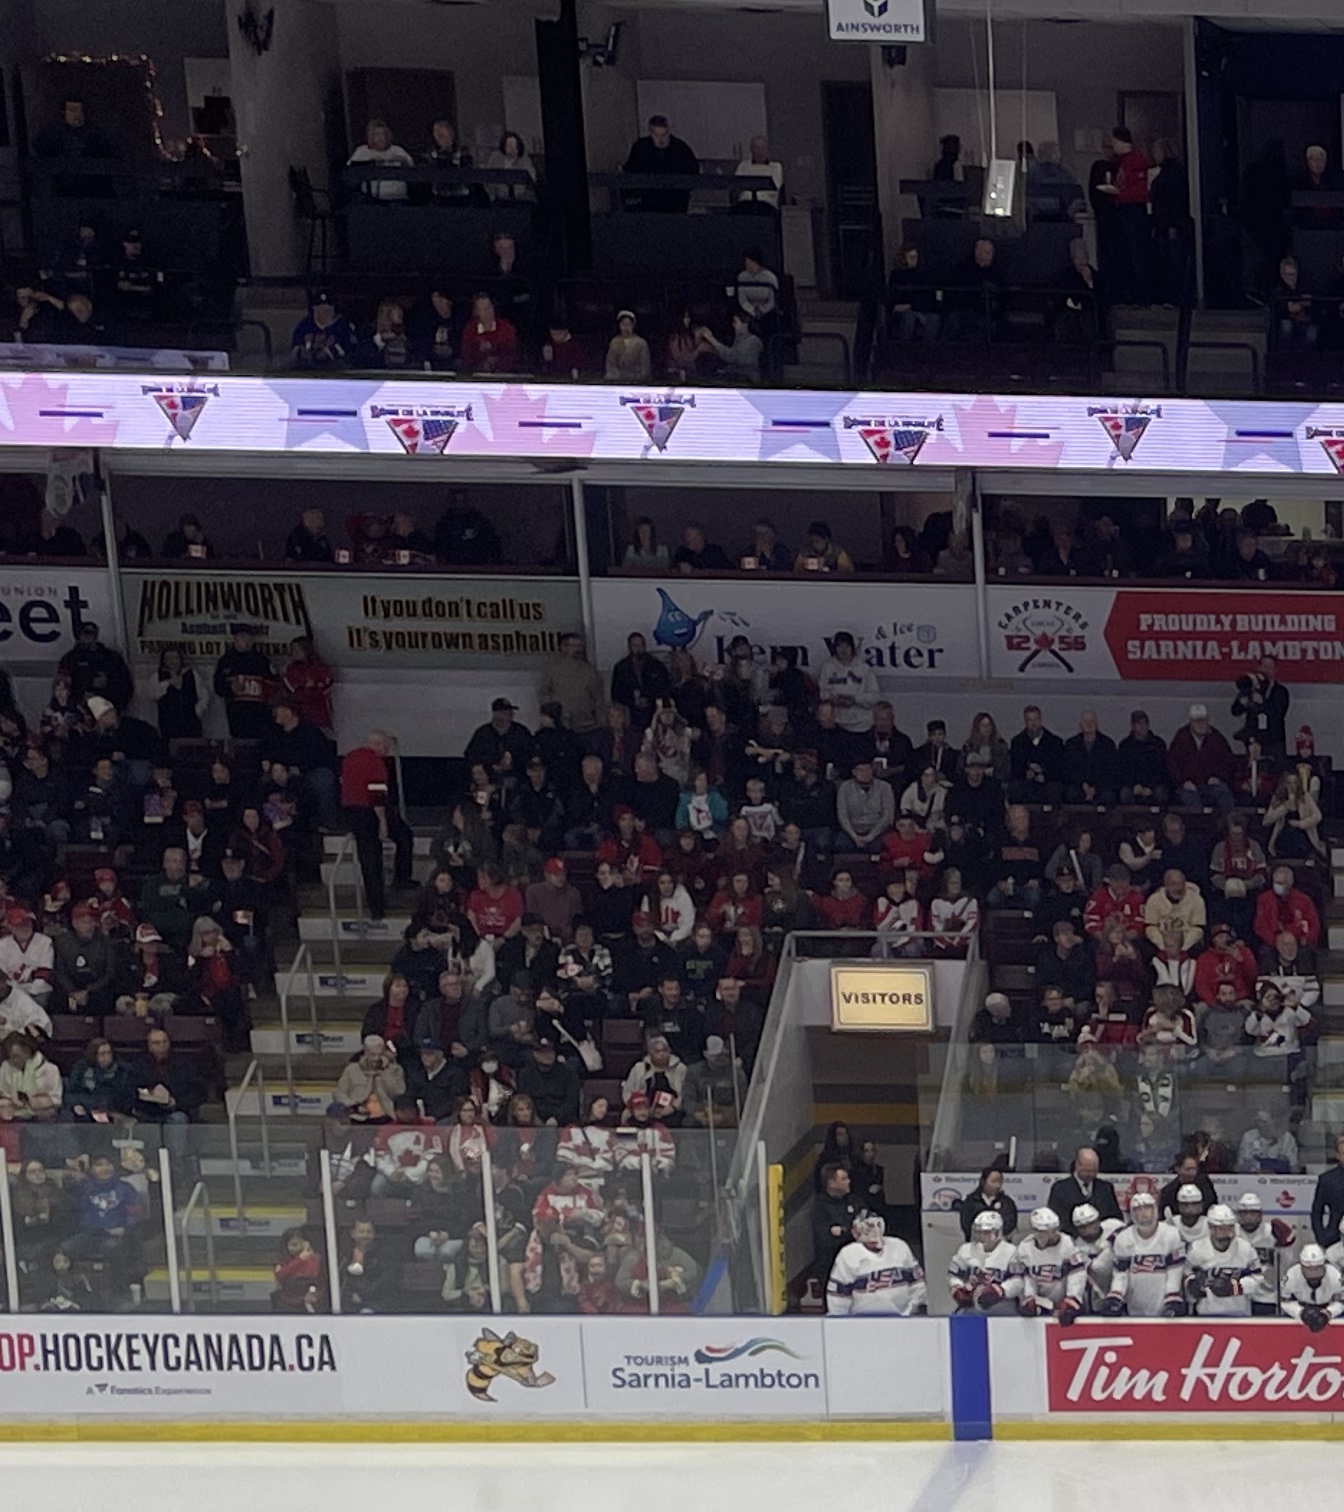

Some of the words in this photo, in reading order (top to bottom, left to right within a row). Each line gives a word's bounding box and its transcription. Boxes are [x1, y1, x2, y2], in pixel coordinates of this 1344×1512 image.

[837, 22, 921, 35] AINSWORTH
[363, 595, 380, 618] If
[380, 599, 417, 620] you
[421, 596, 472, 620] don't
[476, 598, 516, 621] call
[518, 601, 544, 621] us
[1139, 613, 1229, 633] PROUDLY
[1236, 614, 1336, 633] BUILDING
[382, 630, 425, 651] your
[427, 630, 475, 652] own
[841, 991, 924, 1005] VISITORS
[624, 1355, 691, 1367] TOURISM
[1060, 1336, 1169, 1402] Tim
[611, 1367, 821, 1389] Sarnia-Lambton
